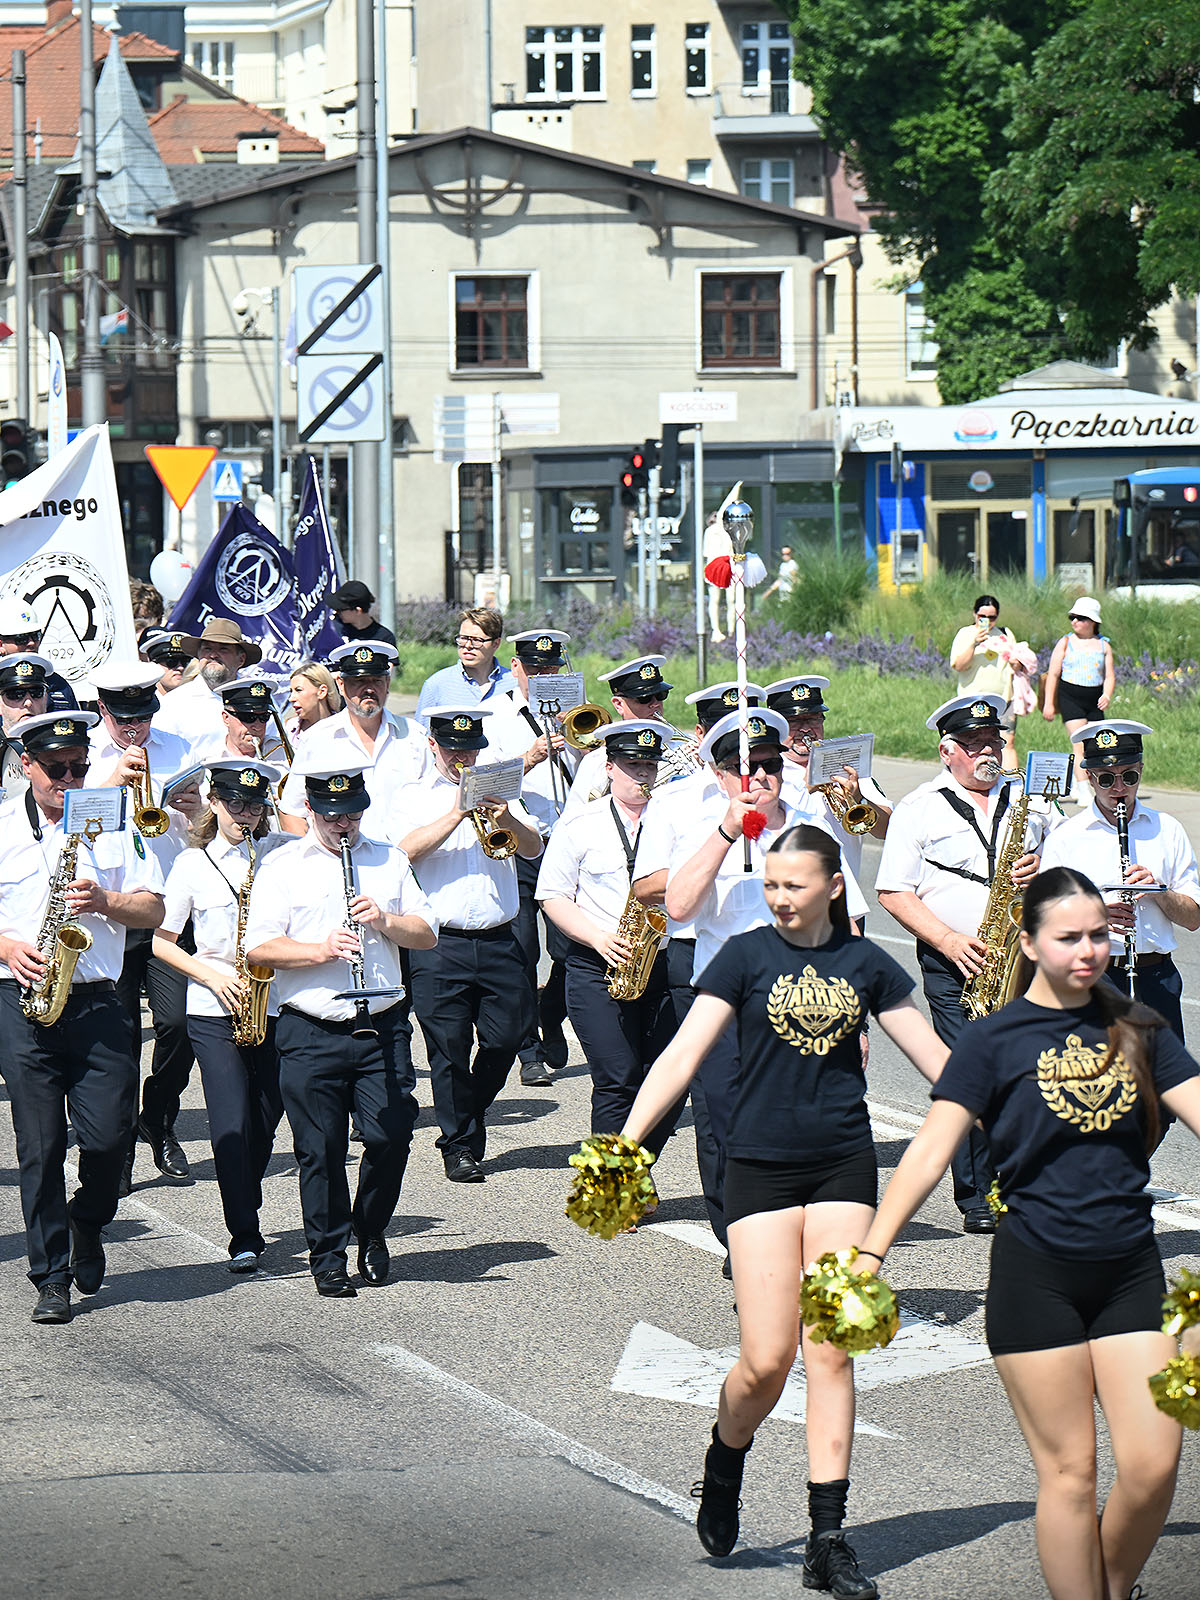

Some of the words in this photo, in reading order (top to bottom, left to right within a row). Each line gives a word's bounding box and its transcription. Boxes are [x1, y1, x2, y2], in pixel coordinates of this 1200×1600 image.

[1010, 410, 1198, 444] Pączkarnia
[48, 647, 75, 660] 1929
[799, 1036, 830, 1056] 30
[1079, 1109, 1112, 1133] 30
